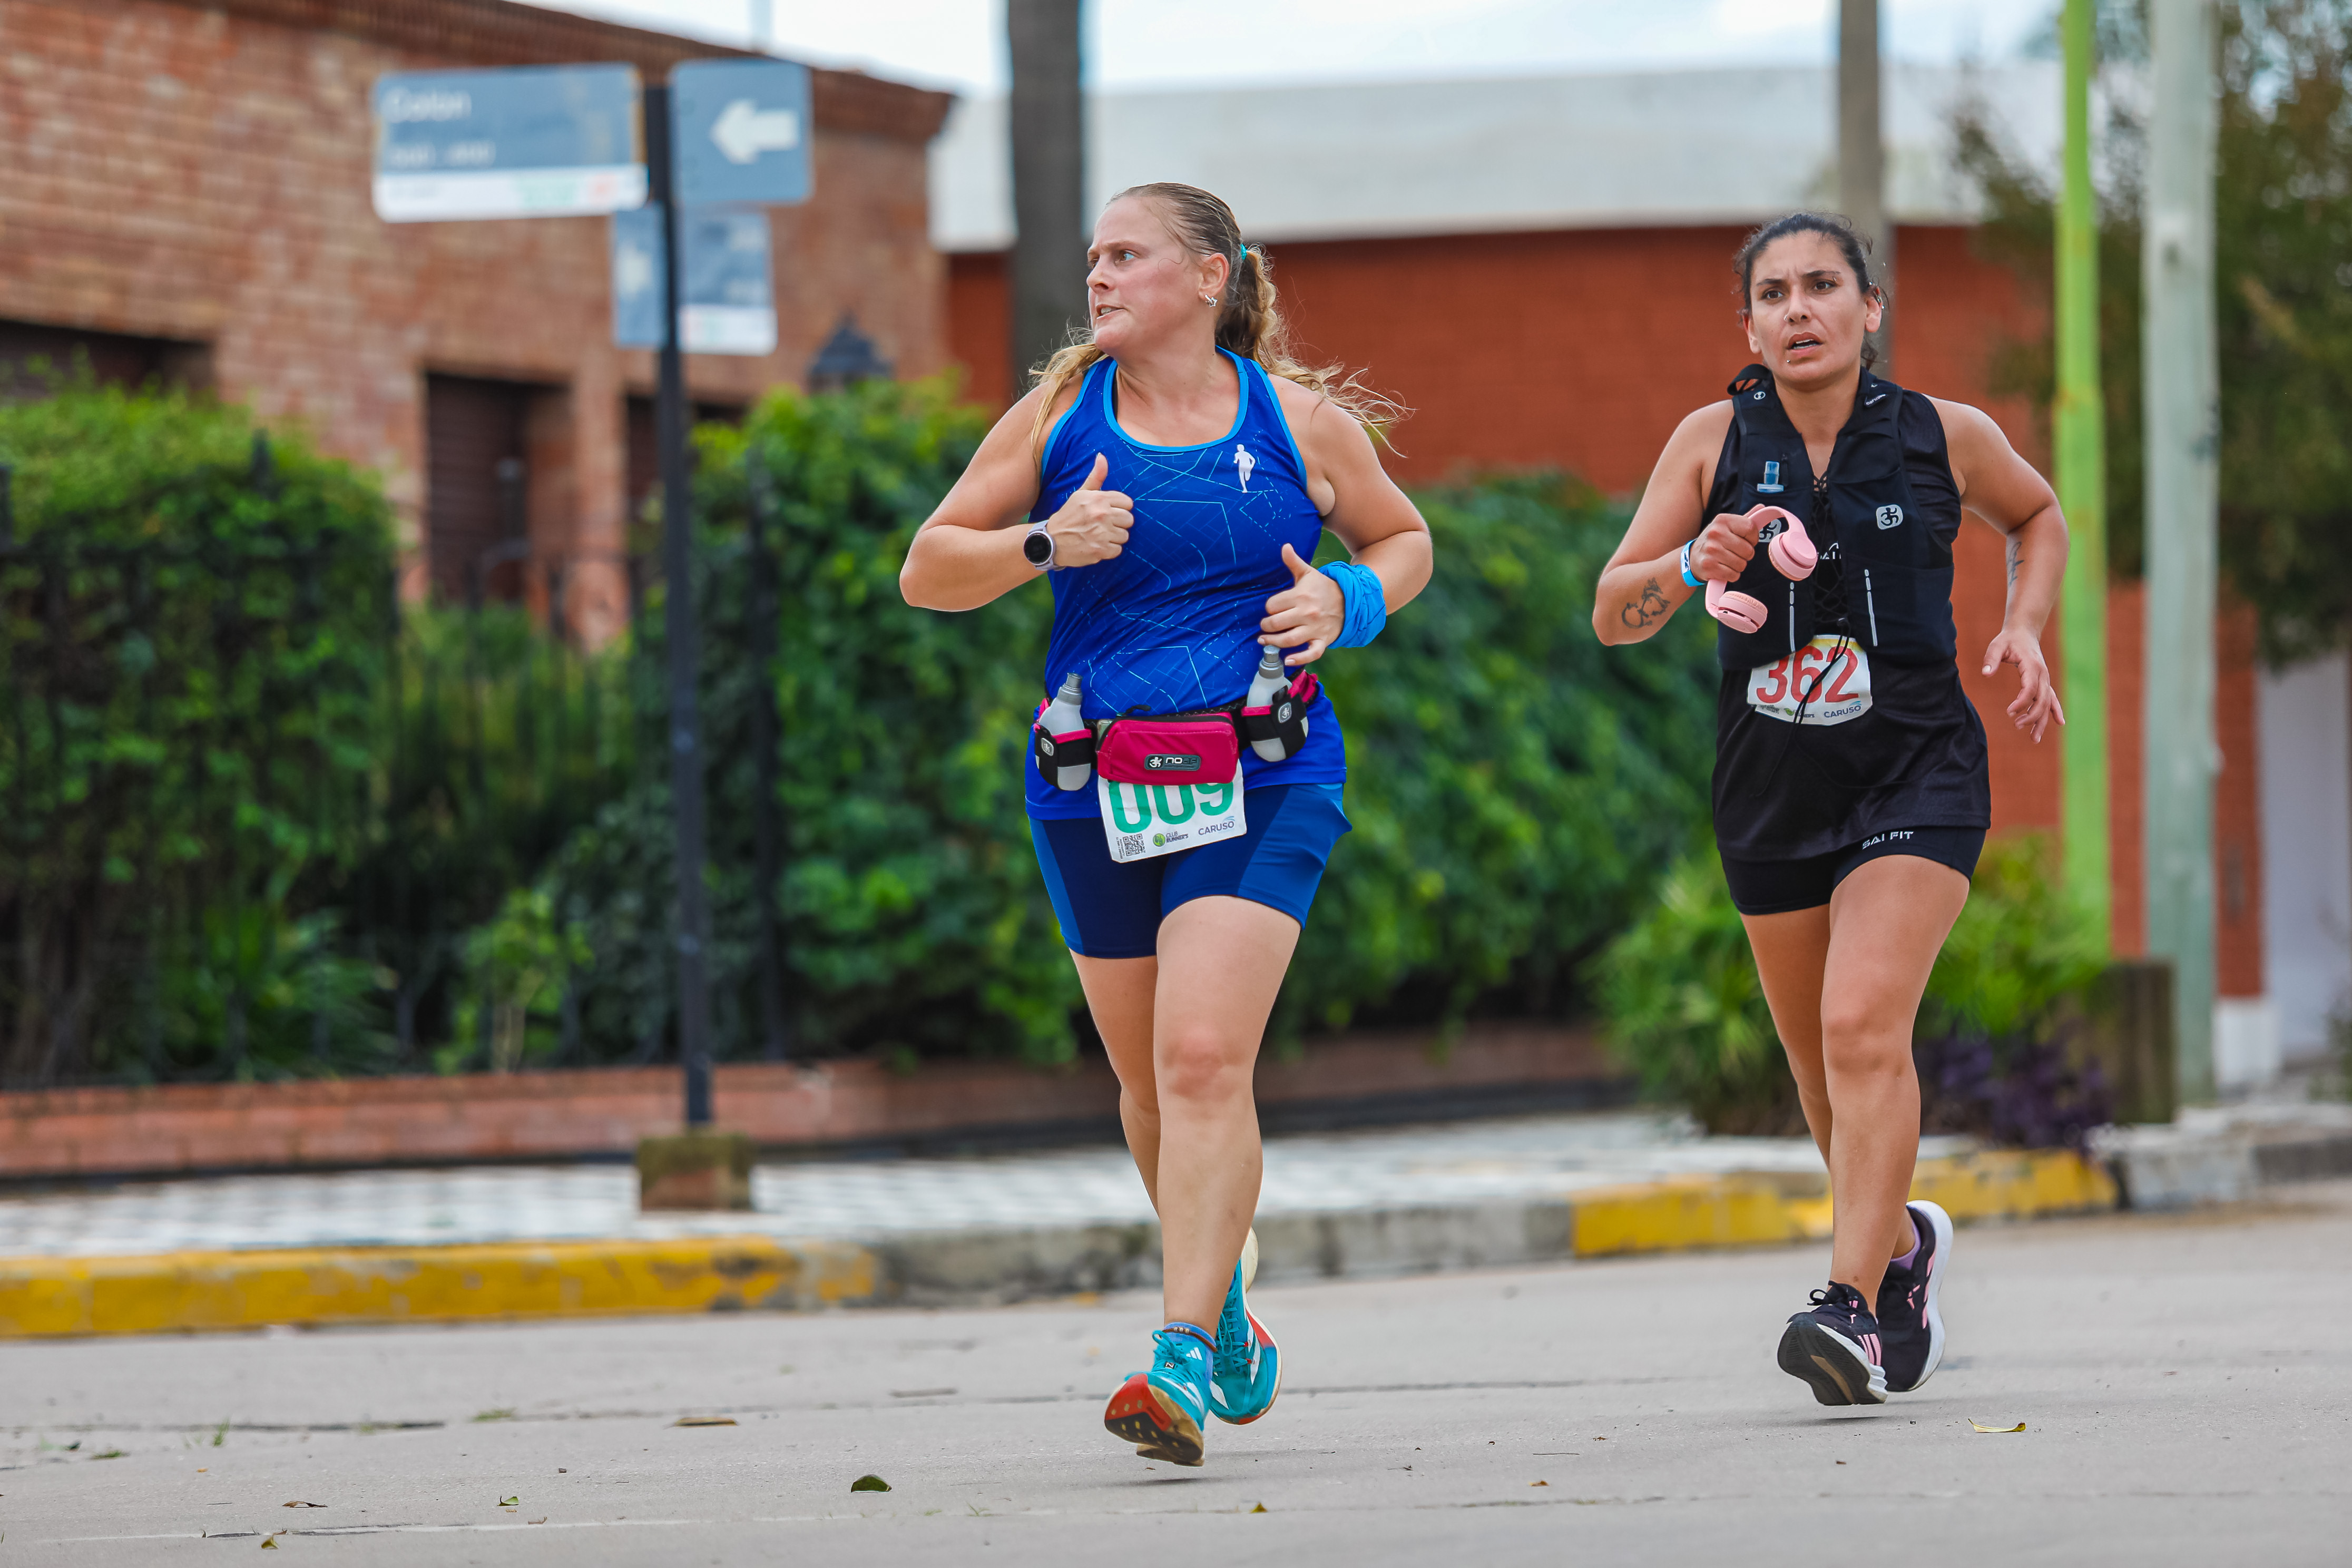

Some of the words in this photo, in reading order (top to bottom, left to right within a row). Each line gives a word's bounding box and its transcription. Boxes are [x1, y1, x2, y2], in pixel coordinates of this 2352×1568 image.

[1756, 645, 1859, 704] 362
[1824, 705, 1861, 718] CARUSO
[1108, 781, 1234, 834] 009
[1198, 821, 1235, 836] CARUSO
[1862, 834, 1885, 850] SAI
[1889, 831, 1914, 840] FIT
